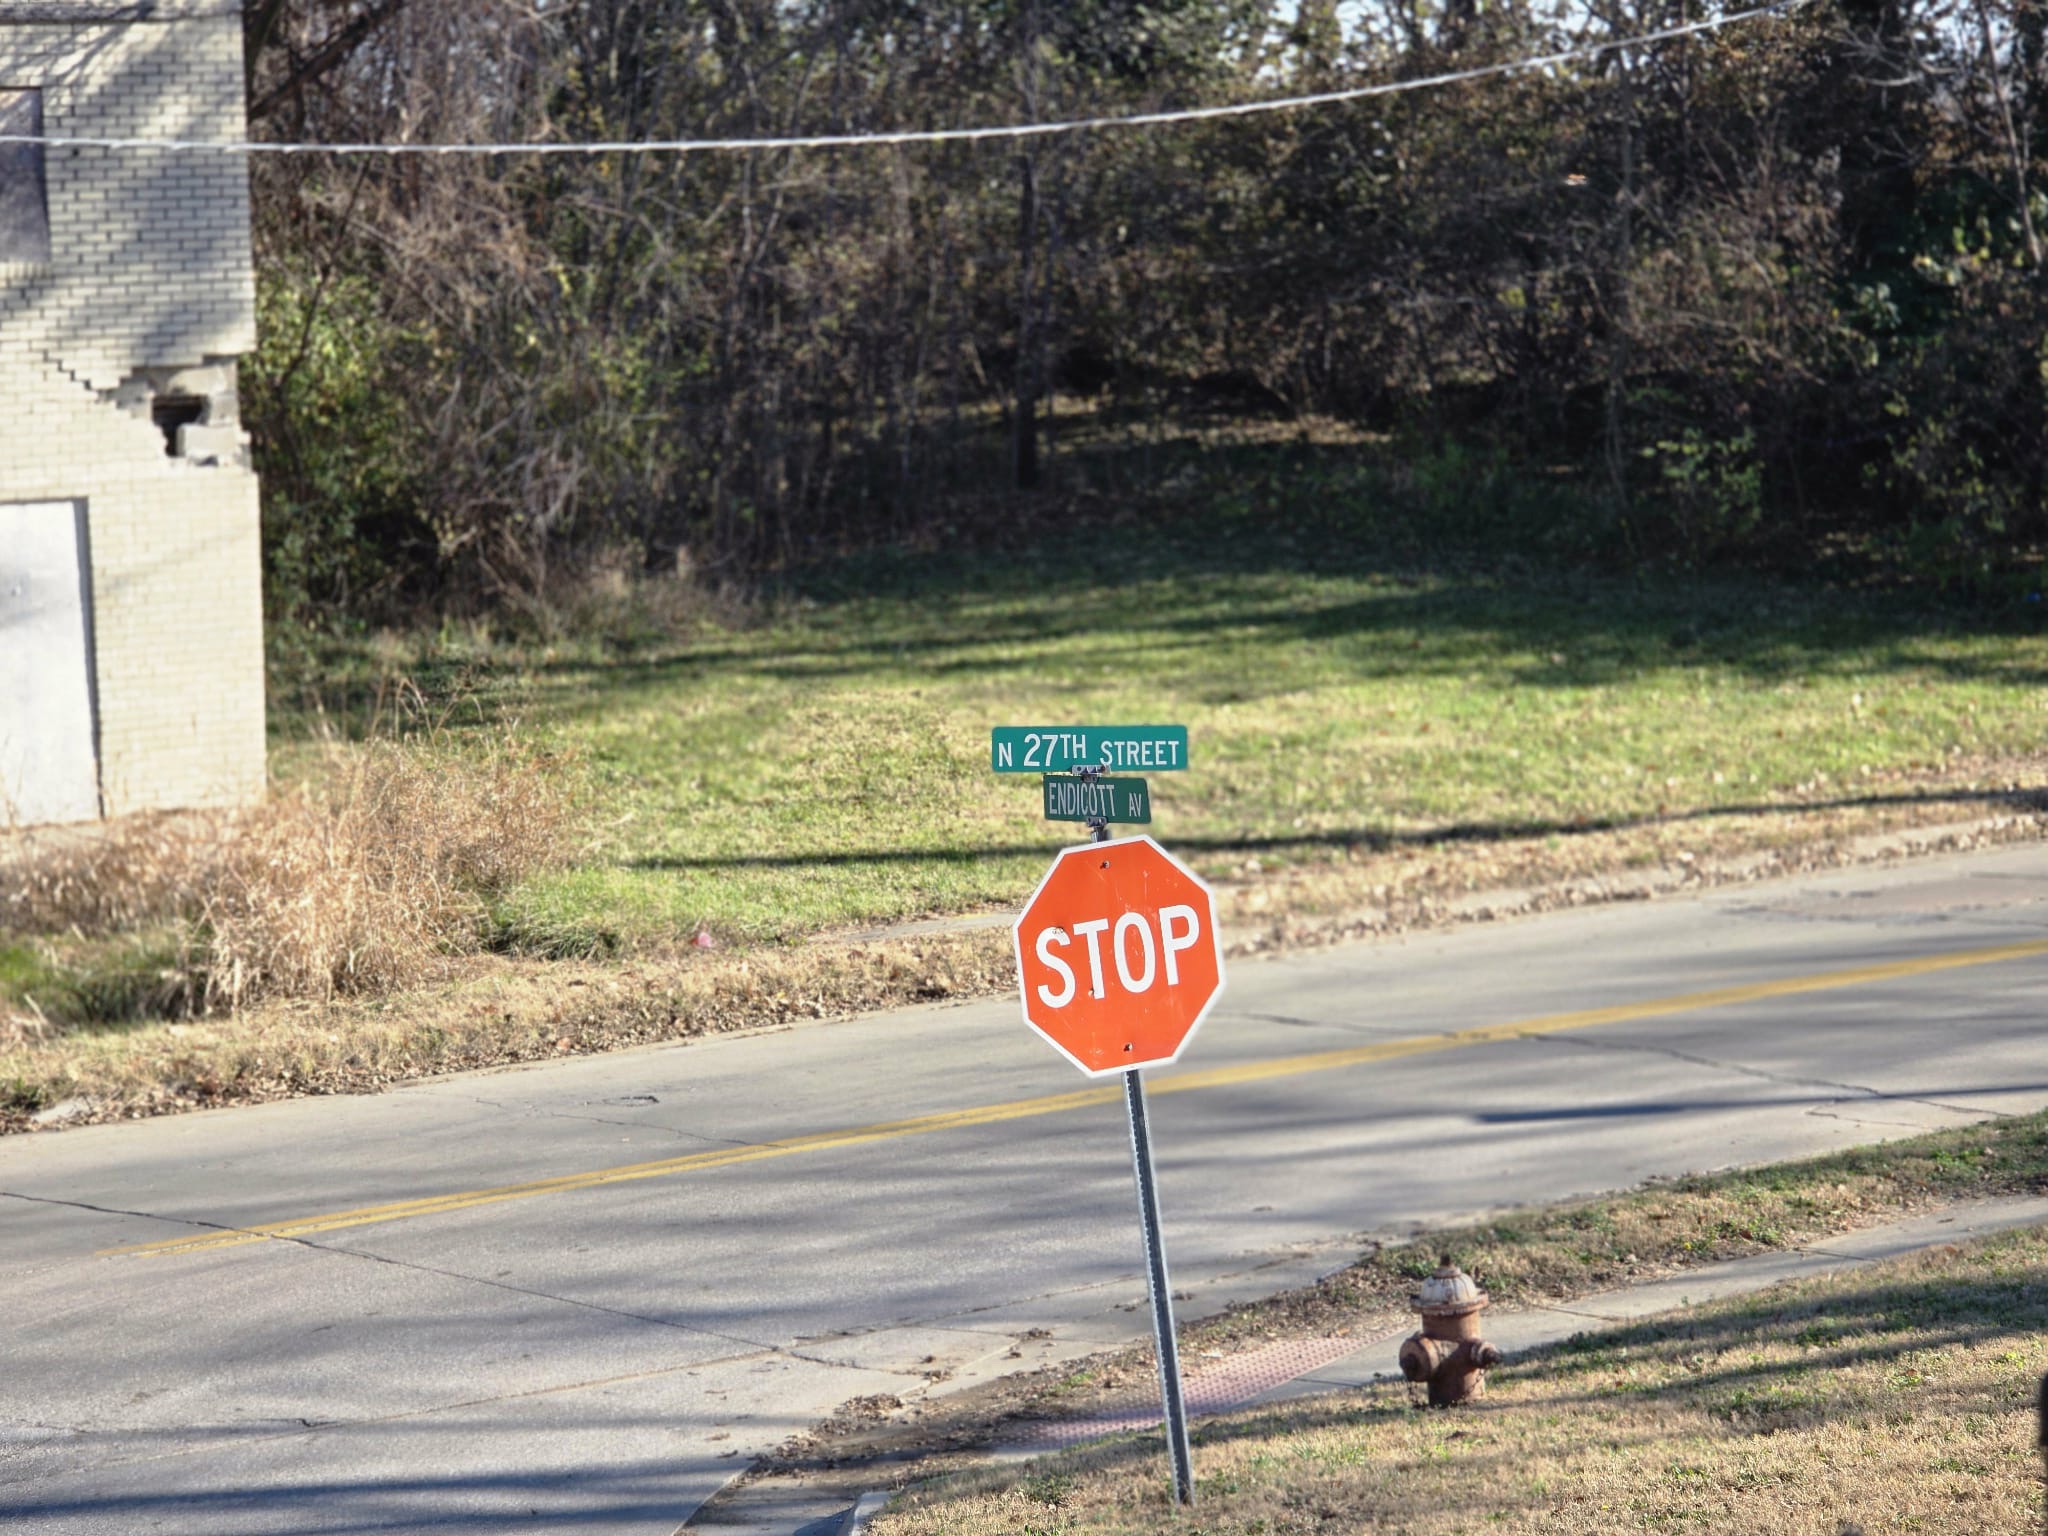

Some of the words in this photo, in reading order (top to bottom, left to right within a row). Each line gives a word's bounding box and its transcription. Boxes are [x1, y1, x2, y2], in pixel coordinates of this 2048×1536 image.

[998, 742, 1013, 767] N
[1023, 733, 1087, 767] 27TH
[1100, 740, 1180, 766] STREET
[1049, 782, 1116, 817] ENDICOTT
[1128, 792, 1142, 818] AV
[1035, 904, 1200, 1008] STOP
